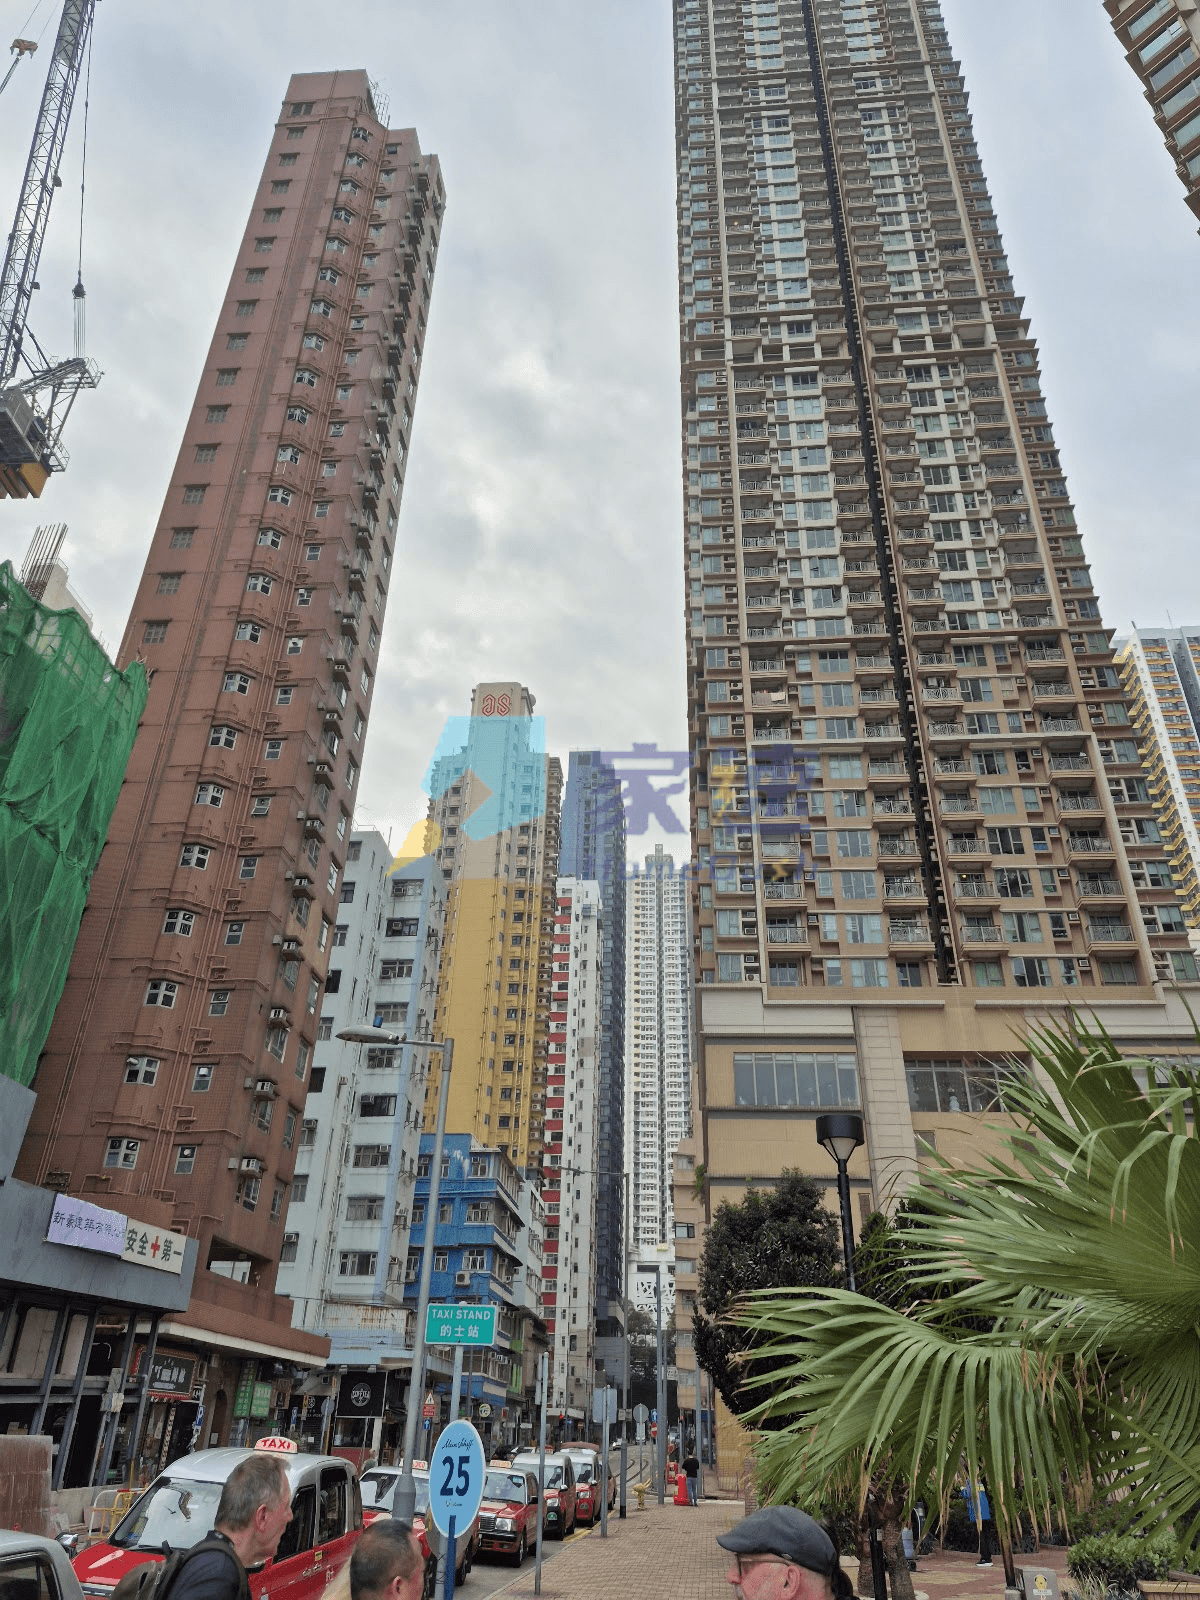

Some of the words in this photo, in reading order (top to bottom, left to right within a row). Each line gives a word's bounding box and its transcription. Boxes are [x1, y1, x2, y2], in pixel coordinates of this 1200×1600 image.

[431, 1309, 453, 1319] TAXI
[456, 1309, 491, 1321] STAND
[440, 1323, 479, 1338] 的士站
[262, 1438, 291, 1450] TAXI
[440, 1455, 470, 1496] 25
